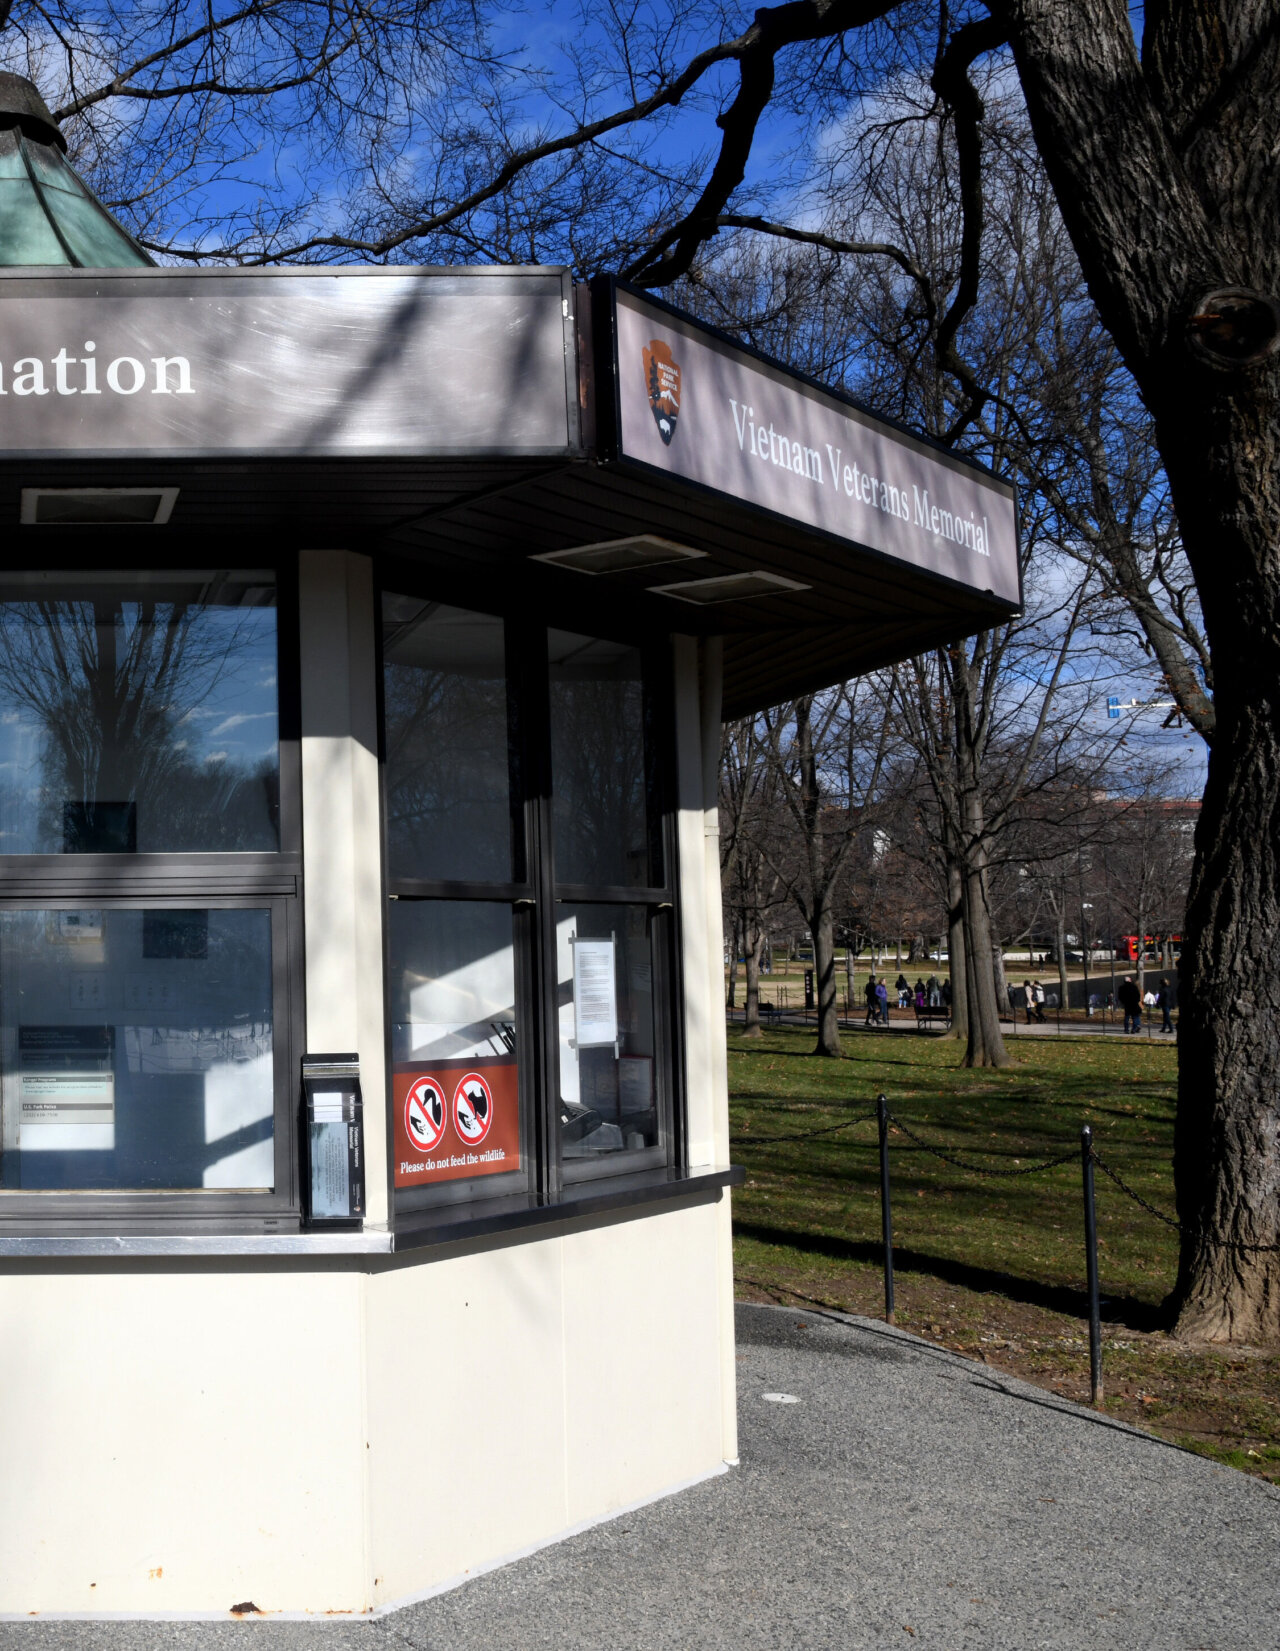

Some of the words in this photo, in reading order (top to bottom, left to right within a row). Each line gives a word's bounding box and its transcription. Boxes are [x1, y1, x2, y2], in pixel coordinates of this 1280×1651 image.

[729, 398, 824, 485] Vietnam
[825, 443, 910, 525] Veterans
[912, 483, 990, 557] Memorial
[400, 1162, 424, 1174] Please
[426, 1159, 435, 1170] do
[437, 1158, 449, 1169] not
[450, 1154, 466, 1166] feed
[467, 1153, 478, 1164] the
[480, 1149, 505, 1162] wildlife
